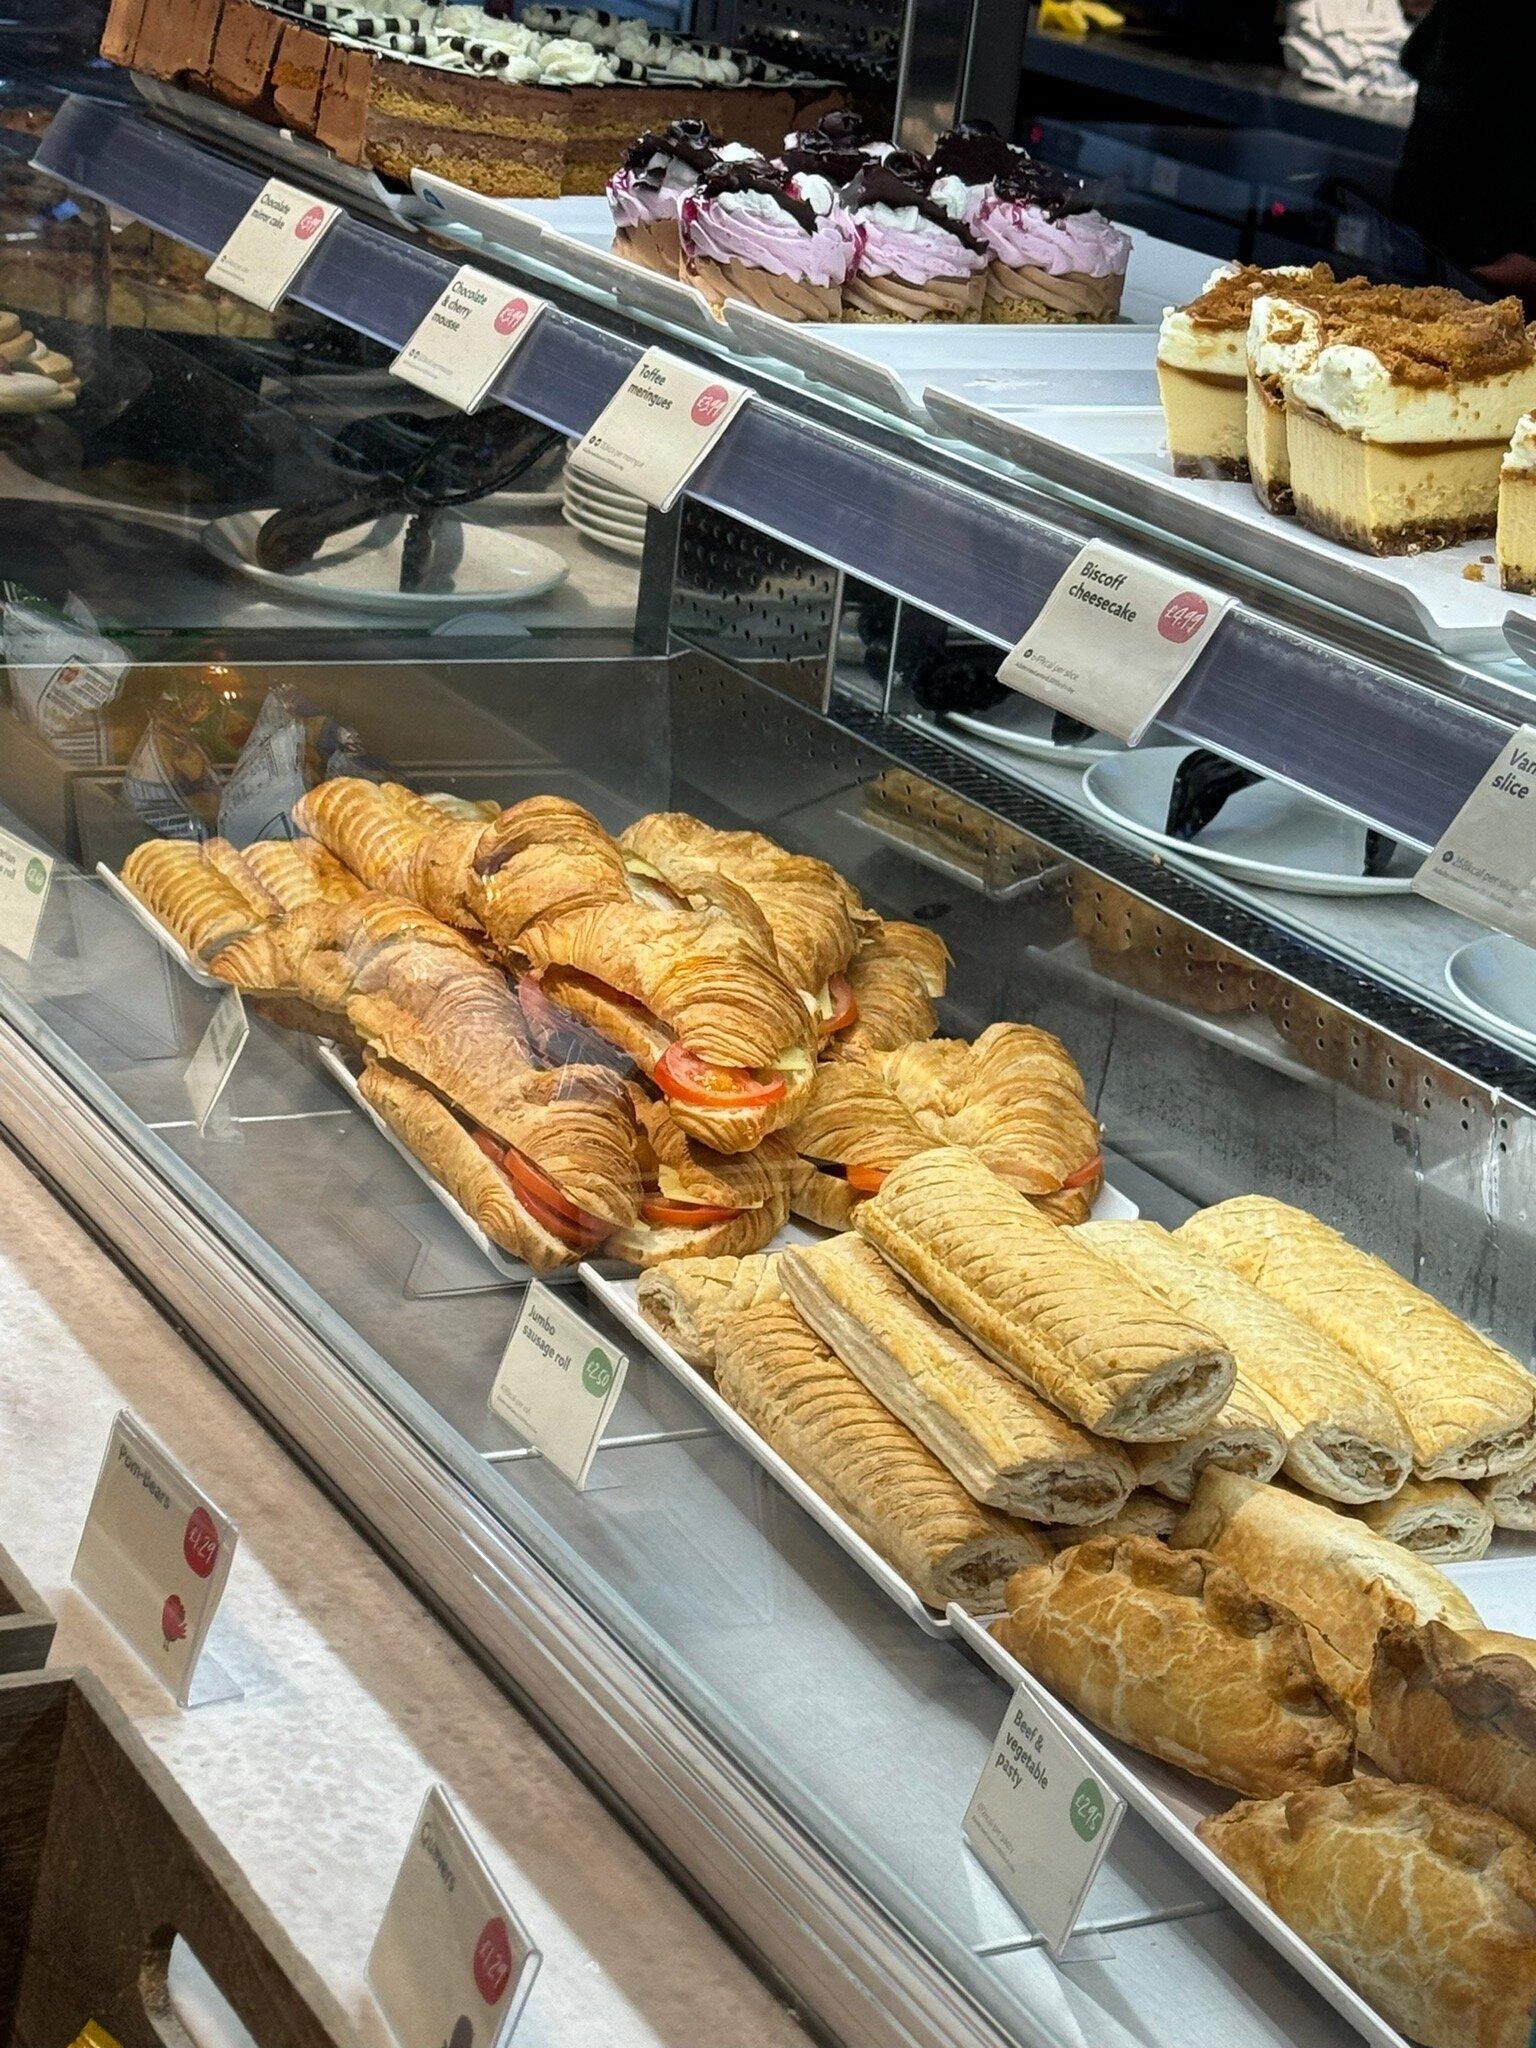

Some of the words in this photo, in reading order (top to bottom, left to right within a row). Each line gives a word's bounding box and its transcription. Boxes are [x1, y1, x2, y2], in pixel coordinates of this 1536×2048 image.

[260, 193, 291, 215] Chocolate
[269, 216, 285, 230] cake
[451, 280, 488, 306] Chocolate
[441, 295, 450, 307] &
[447, 298, 472, 320] cherry
[431, 312, 461, 333] mousse
[638, 363, 667, 387] Toffee
[627, 383, 673, 411] meringues
[1080, 560, 1129, 591] Biscoff
[1068, 581, 1137, 623] cheesecake
[1163, 604, 1206, 634] £4.99
[1491, 772, 1530, 800] slice
[528, 1304, 556, 1336] Jumbo
[522, 1324, 556, 1359] sausage
[554, 1352, 572, 1372] roll
[586, 1360, 611, 1388] £2.50
[1013, 1708, 1036, 1744] Beef
[1034, 1736, 1045, 1754] &
[995, 1752, 1024, 1791] pasty
[1005, 1731, 1049, 1790] vegetable
